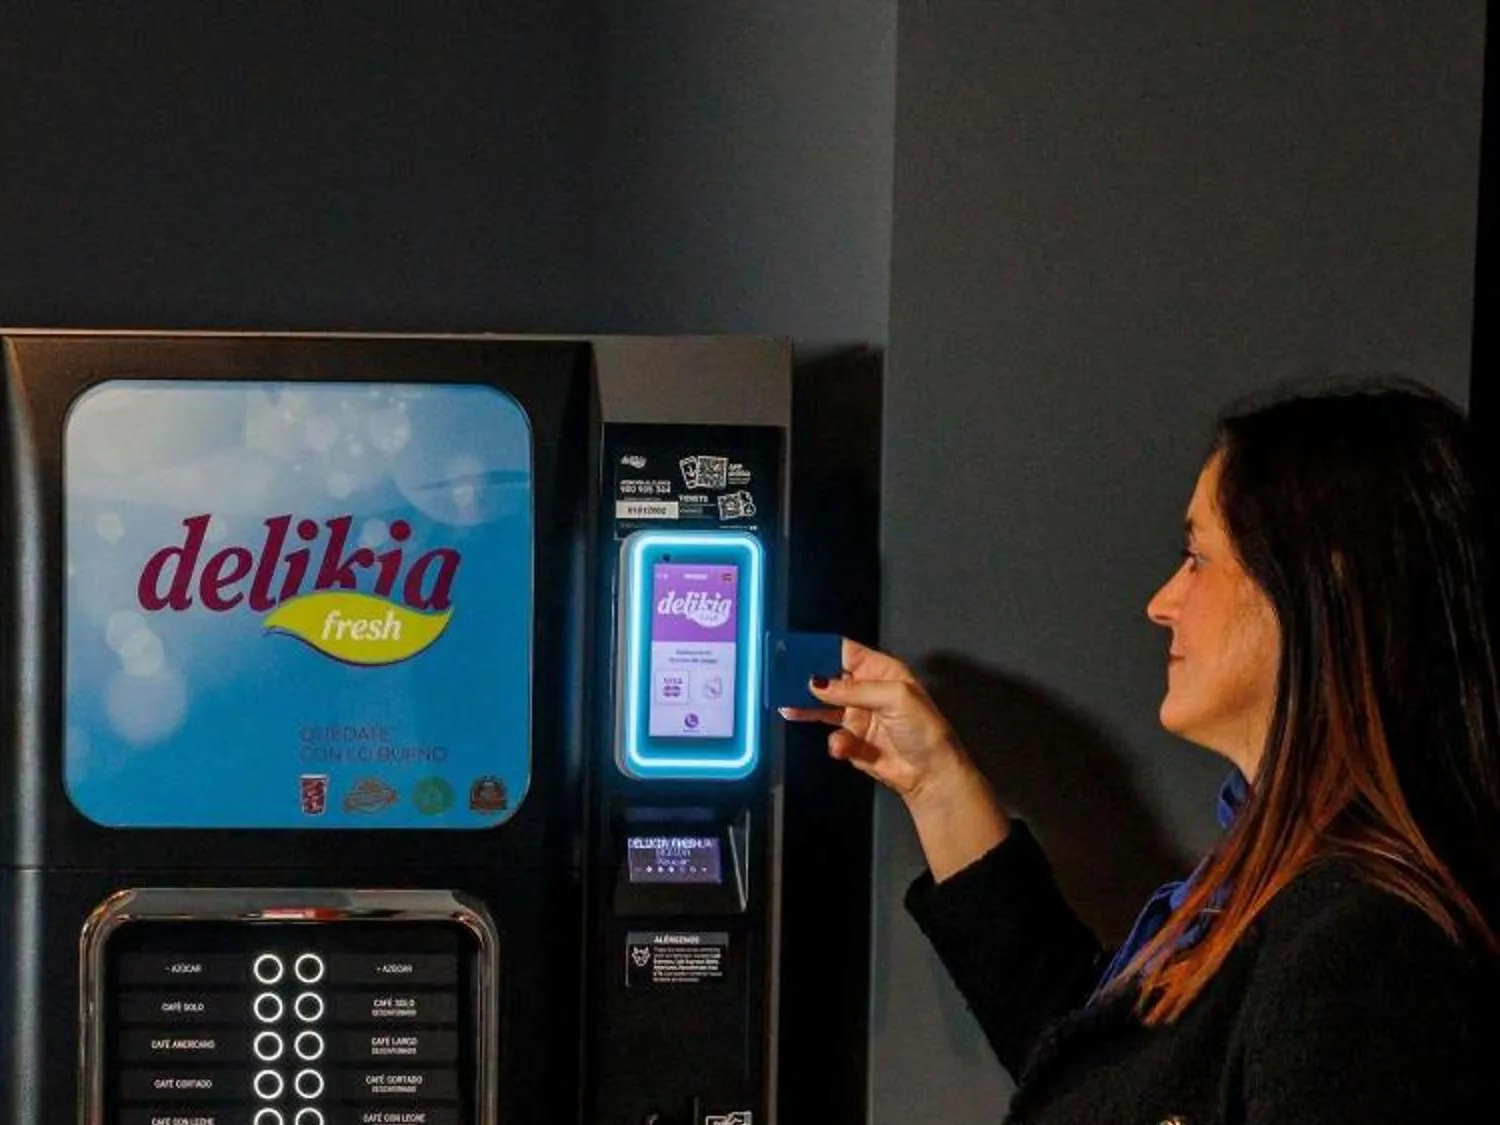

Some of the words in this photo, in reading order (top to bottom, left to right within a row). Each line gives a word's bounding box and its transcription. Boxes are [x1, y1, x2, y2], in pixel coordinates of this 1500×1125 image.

[137, 514, 462, 612] delikia
[320, 610, 403, 642] fresh
[377, 748, 447, 763] BUENO
